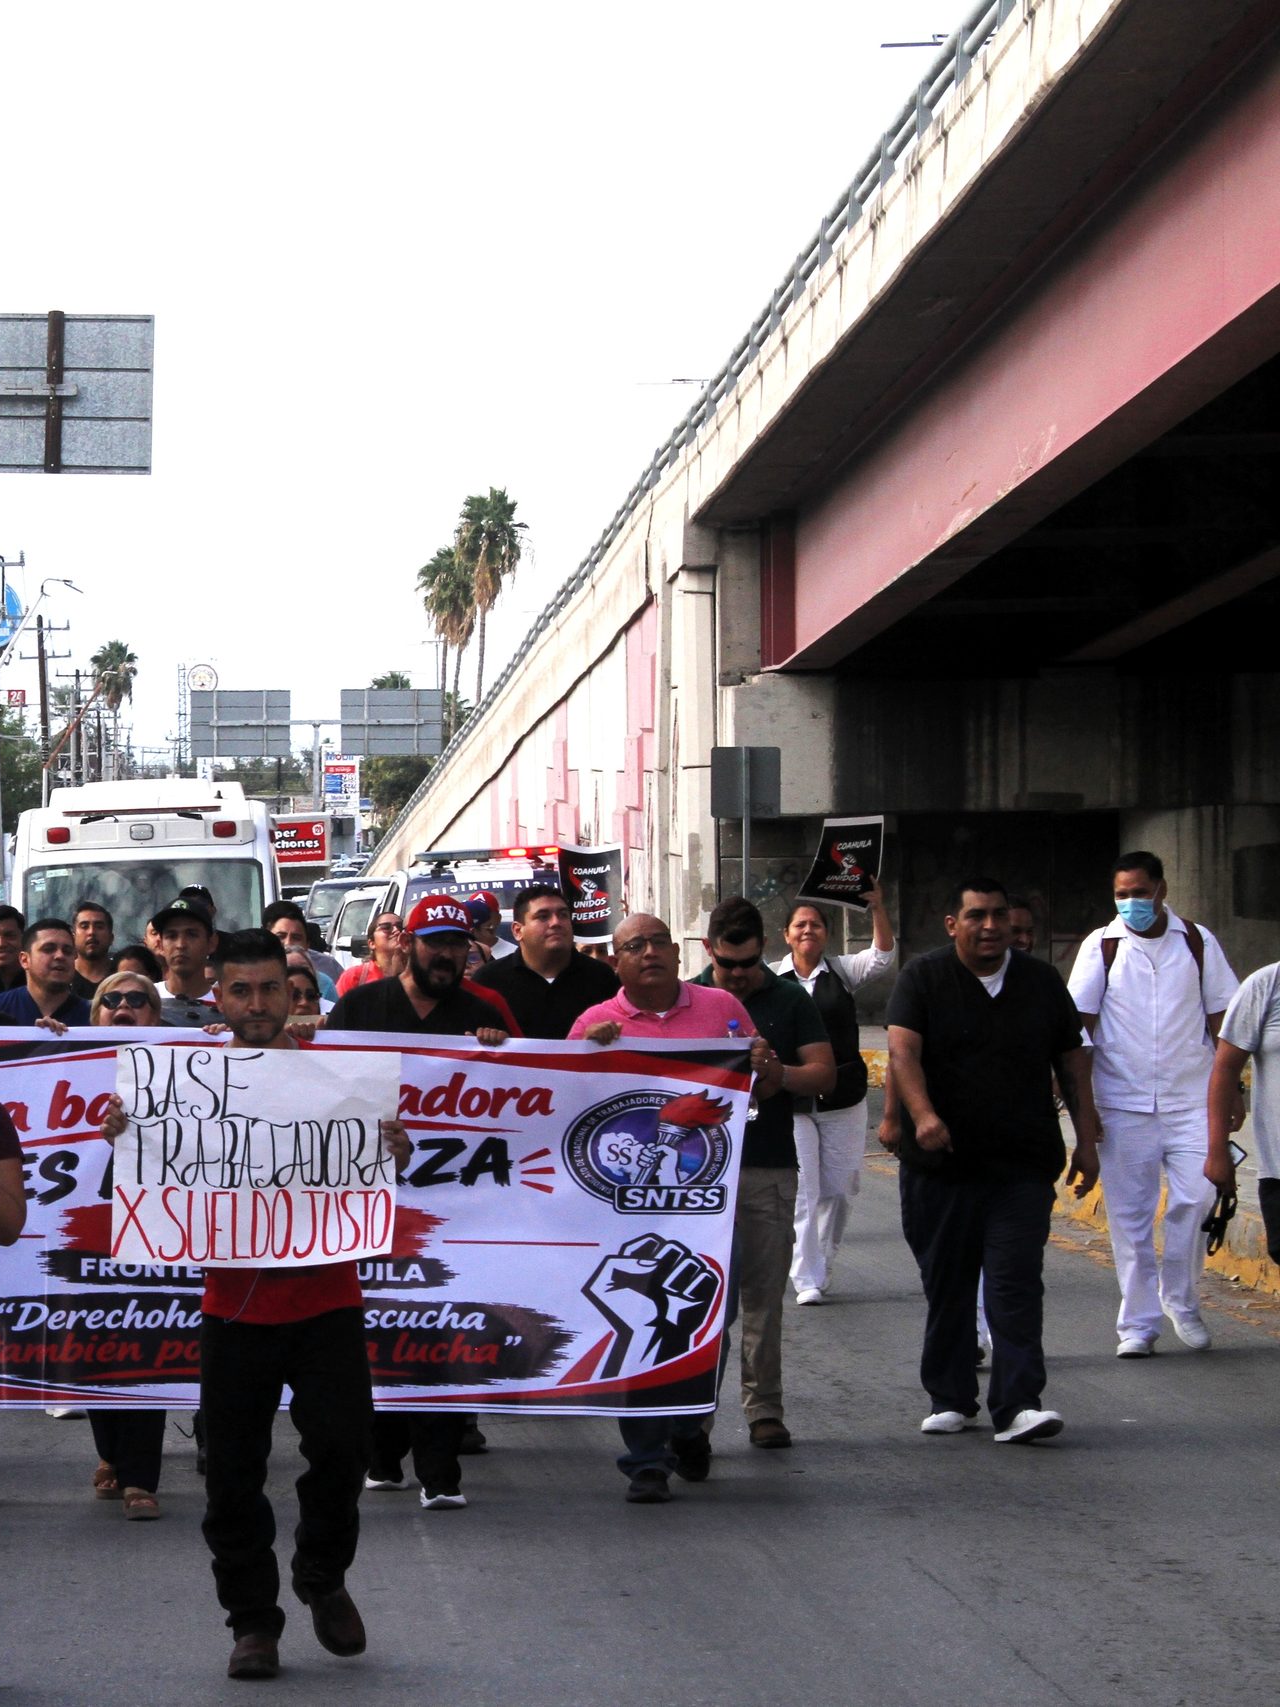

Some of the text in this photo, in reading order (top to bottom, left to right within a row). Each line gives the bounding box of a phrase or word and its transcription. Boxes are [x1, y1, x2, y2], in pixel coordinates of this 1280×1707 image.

[275, 829, 296, 839] per
[276, 839, 320, 850] chones
[836, 839, 872, 851] COAHUILA
[573, 864, 611, 875] COAHUILA
[826, 873, 861, 882] UNIDOS
[817, 883, 862, 892] FUERTES
[573, 897, 607, 908] UNIDOS
[426, 905, 468, 925] MVA
[571, 907, 612, 921] FUERTES
[125, 1047, 264, 1120] BASE
[3, 1101, 32, 1132] a
[397, 1072, 556, 1119] adora
[597, 1096, 668, 1117] TRABAJADORES
[623, 1187, 721, 1209] SNTSS
[364, 1302, 487, 1331] scucha
